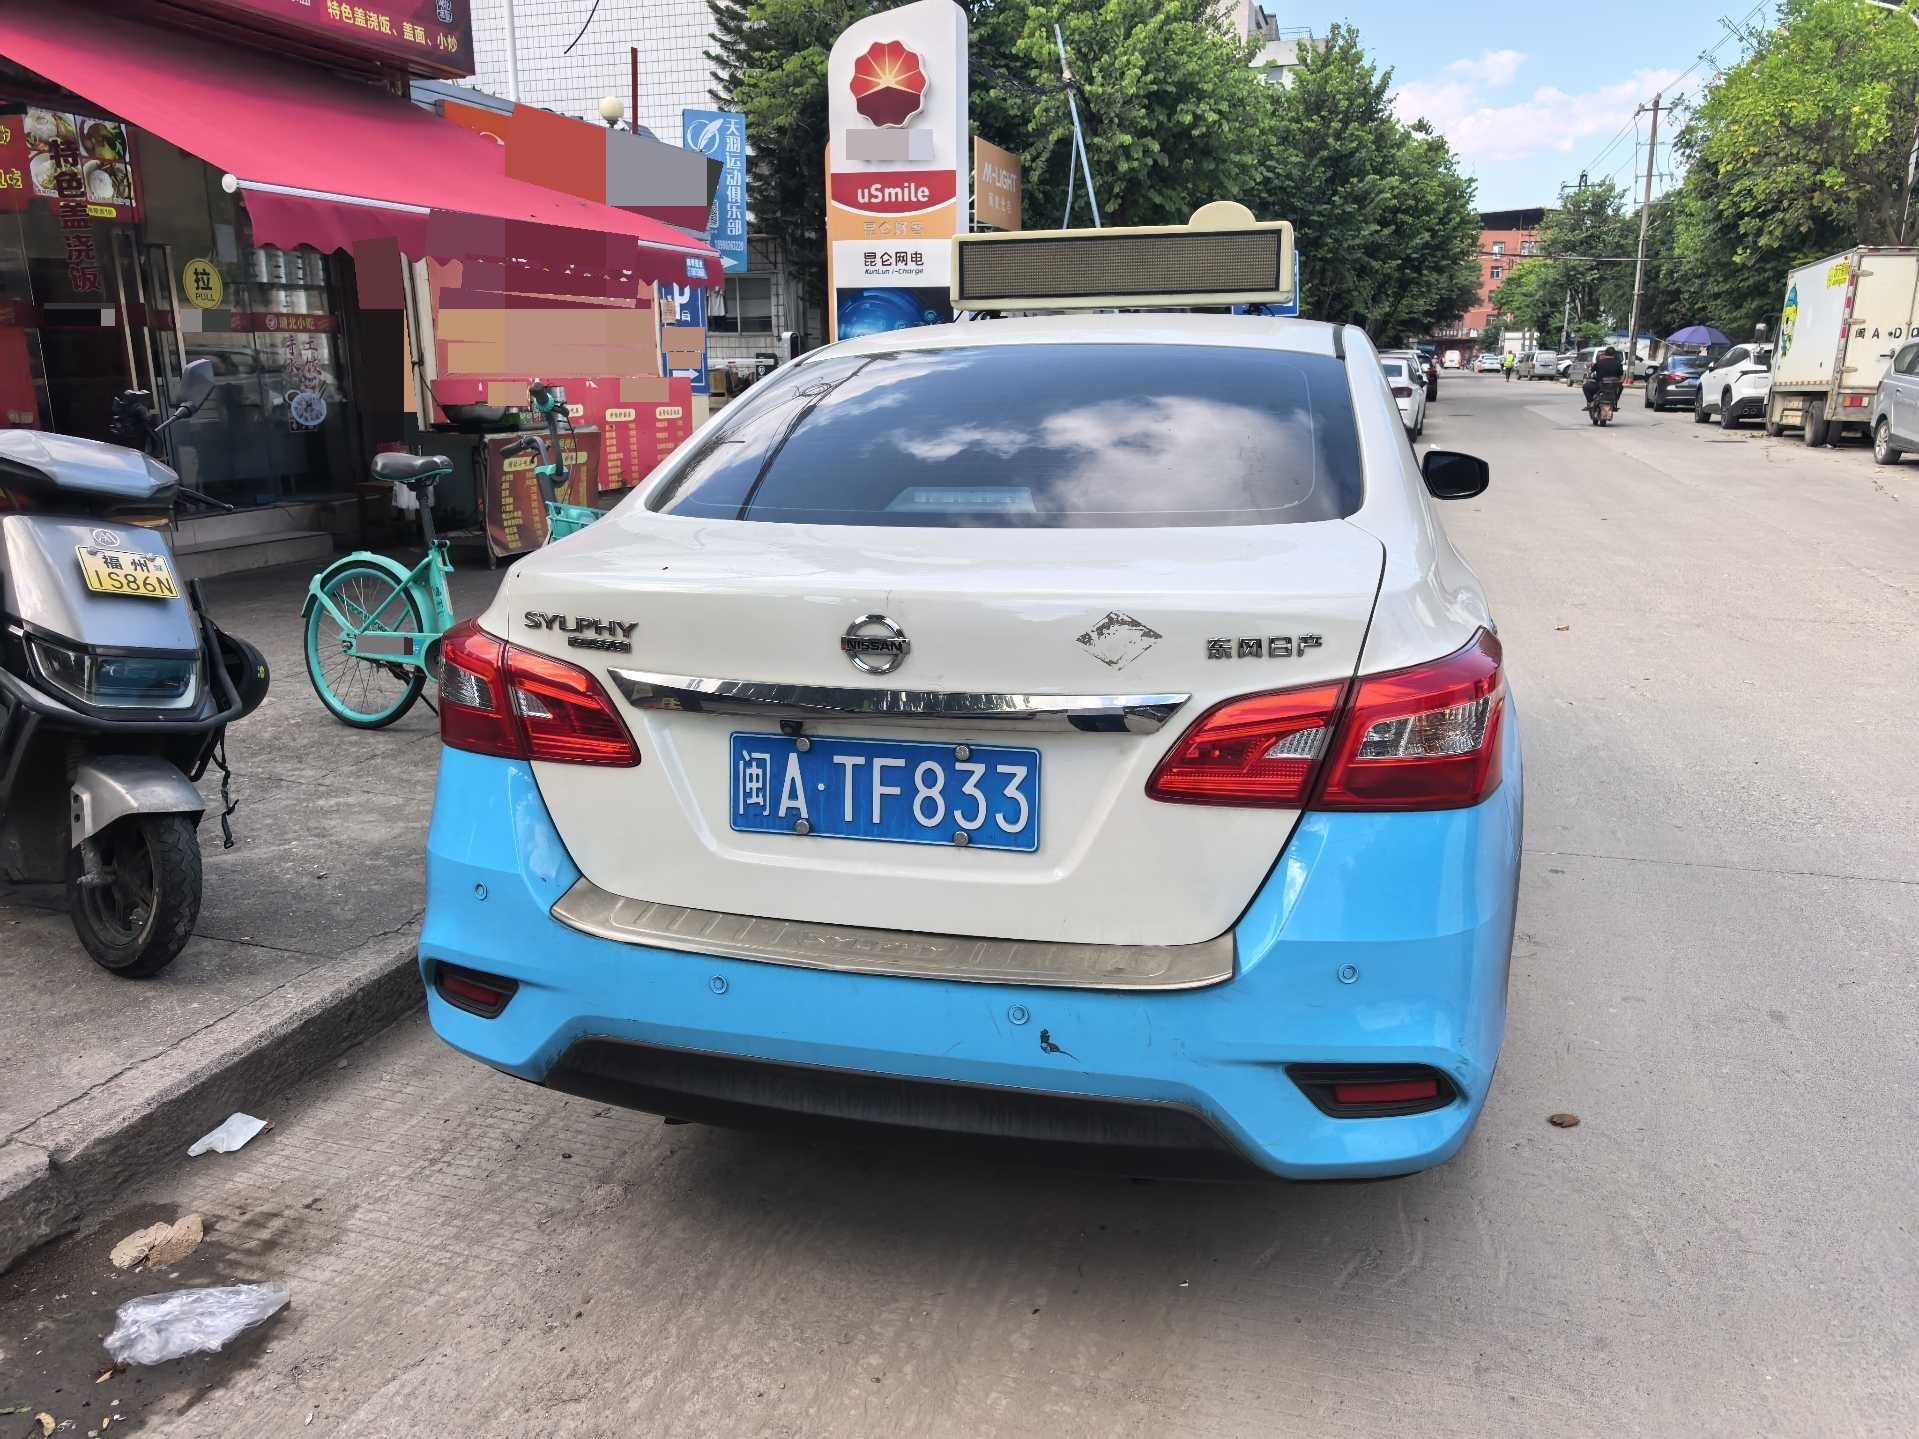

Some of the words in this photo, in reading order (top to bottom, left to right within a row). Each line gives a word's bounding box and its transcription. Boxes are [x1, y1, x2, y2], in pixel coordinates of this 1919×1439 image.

[857, 183, 929, 205] uSmile
[864, 251, 924, 267] 昆仑网电
[194, 267, 213, 291] 拉
[195, 293, 216, 301] PULL
[102, 555, 150, 573] 福州
[94, 570, 174, 595] 1S86N
[523, 611, 639, 638] SYLPHY
[847, 640, 903, 652] NISSAN
[1207, 634, 1323, 660] 东风日产
[738, 749, 1030, 834] 闽A·TF833
